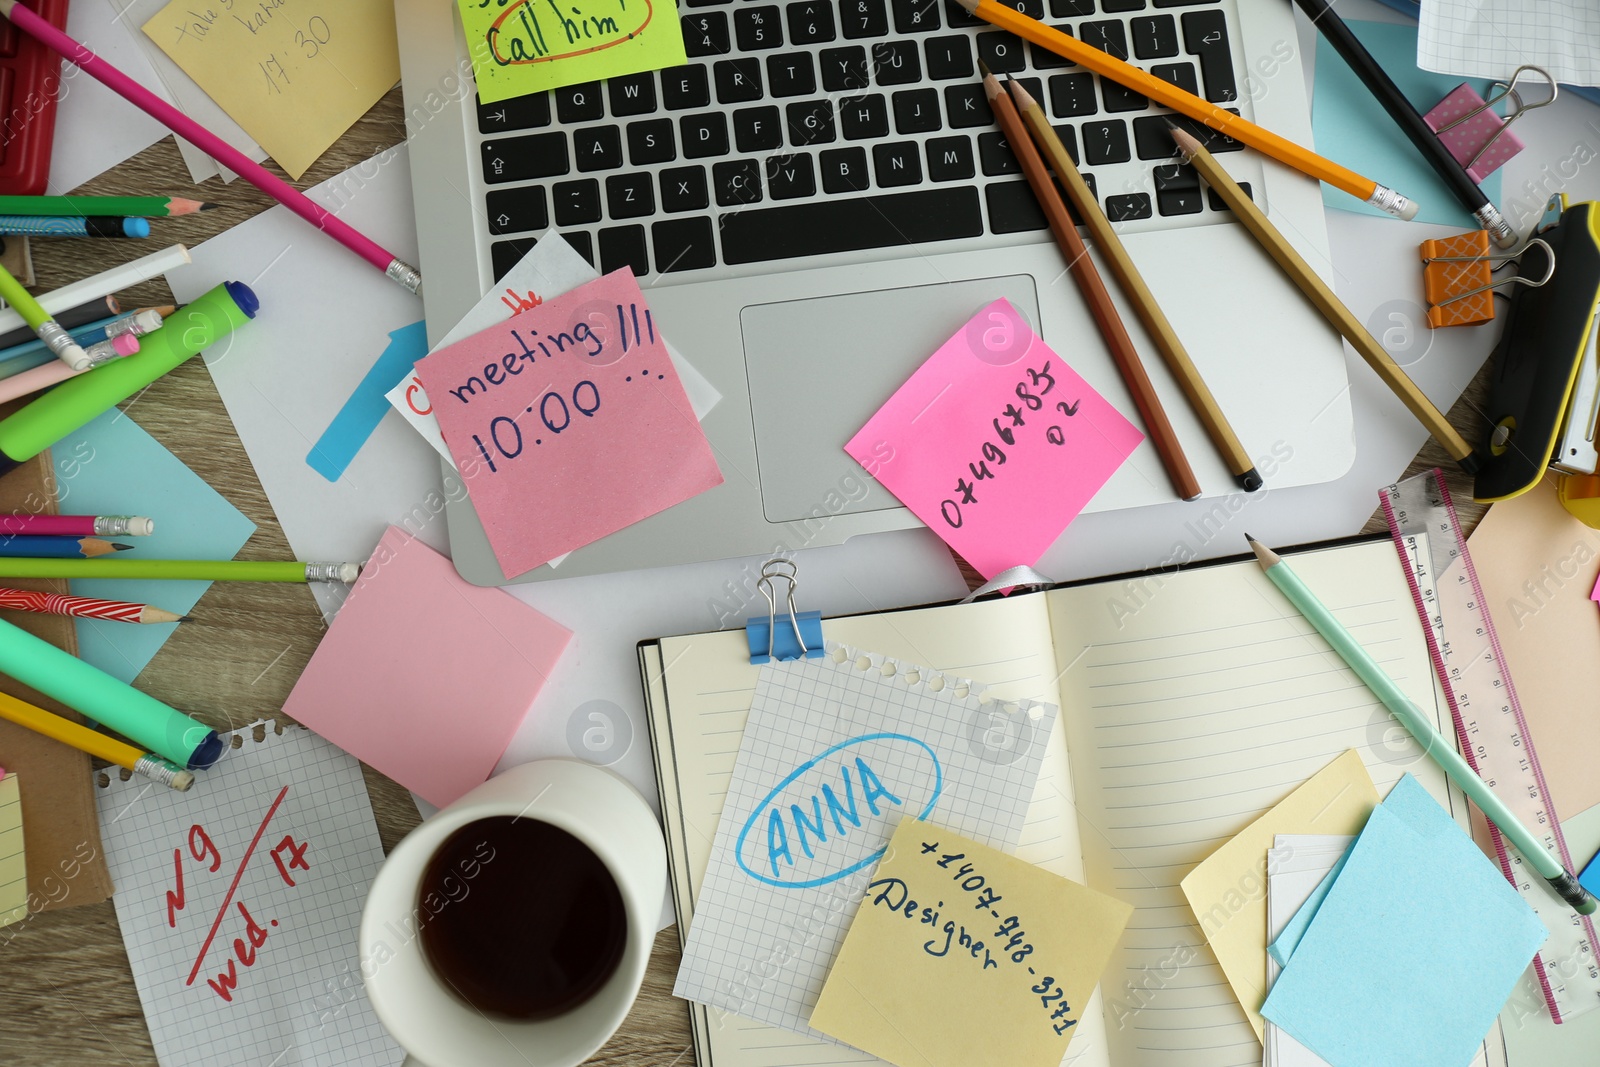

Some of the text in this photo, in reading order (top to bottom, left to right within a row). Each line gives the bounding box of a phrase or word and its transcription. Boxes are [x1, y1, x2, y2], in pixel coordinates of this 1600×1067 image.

[174, 10, 218, 44] take
[574, 93, 585, 105] Q
[625, 85, 638, 97] W
[682, 80, 688, 92] E
[735, 74, 743, 85] R
[788, 67, 794, 78] T
[840, 61, 847, 73] Y
[892, 56, 902, 67] U
[996, 45, 1006, 56] O
[593, 98, 974, 153] A S D F G H J K
[625, 151, 957, 201] Z X C V B N M
[449, 322, 603, 404] meeting
[472, 380, 600, 472] 10:00
[767, 757, 902, 877] ANNA
[865, 878, 998, 970] Designer
